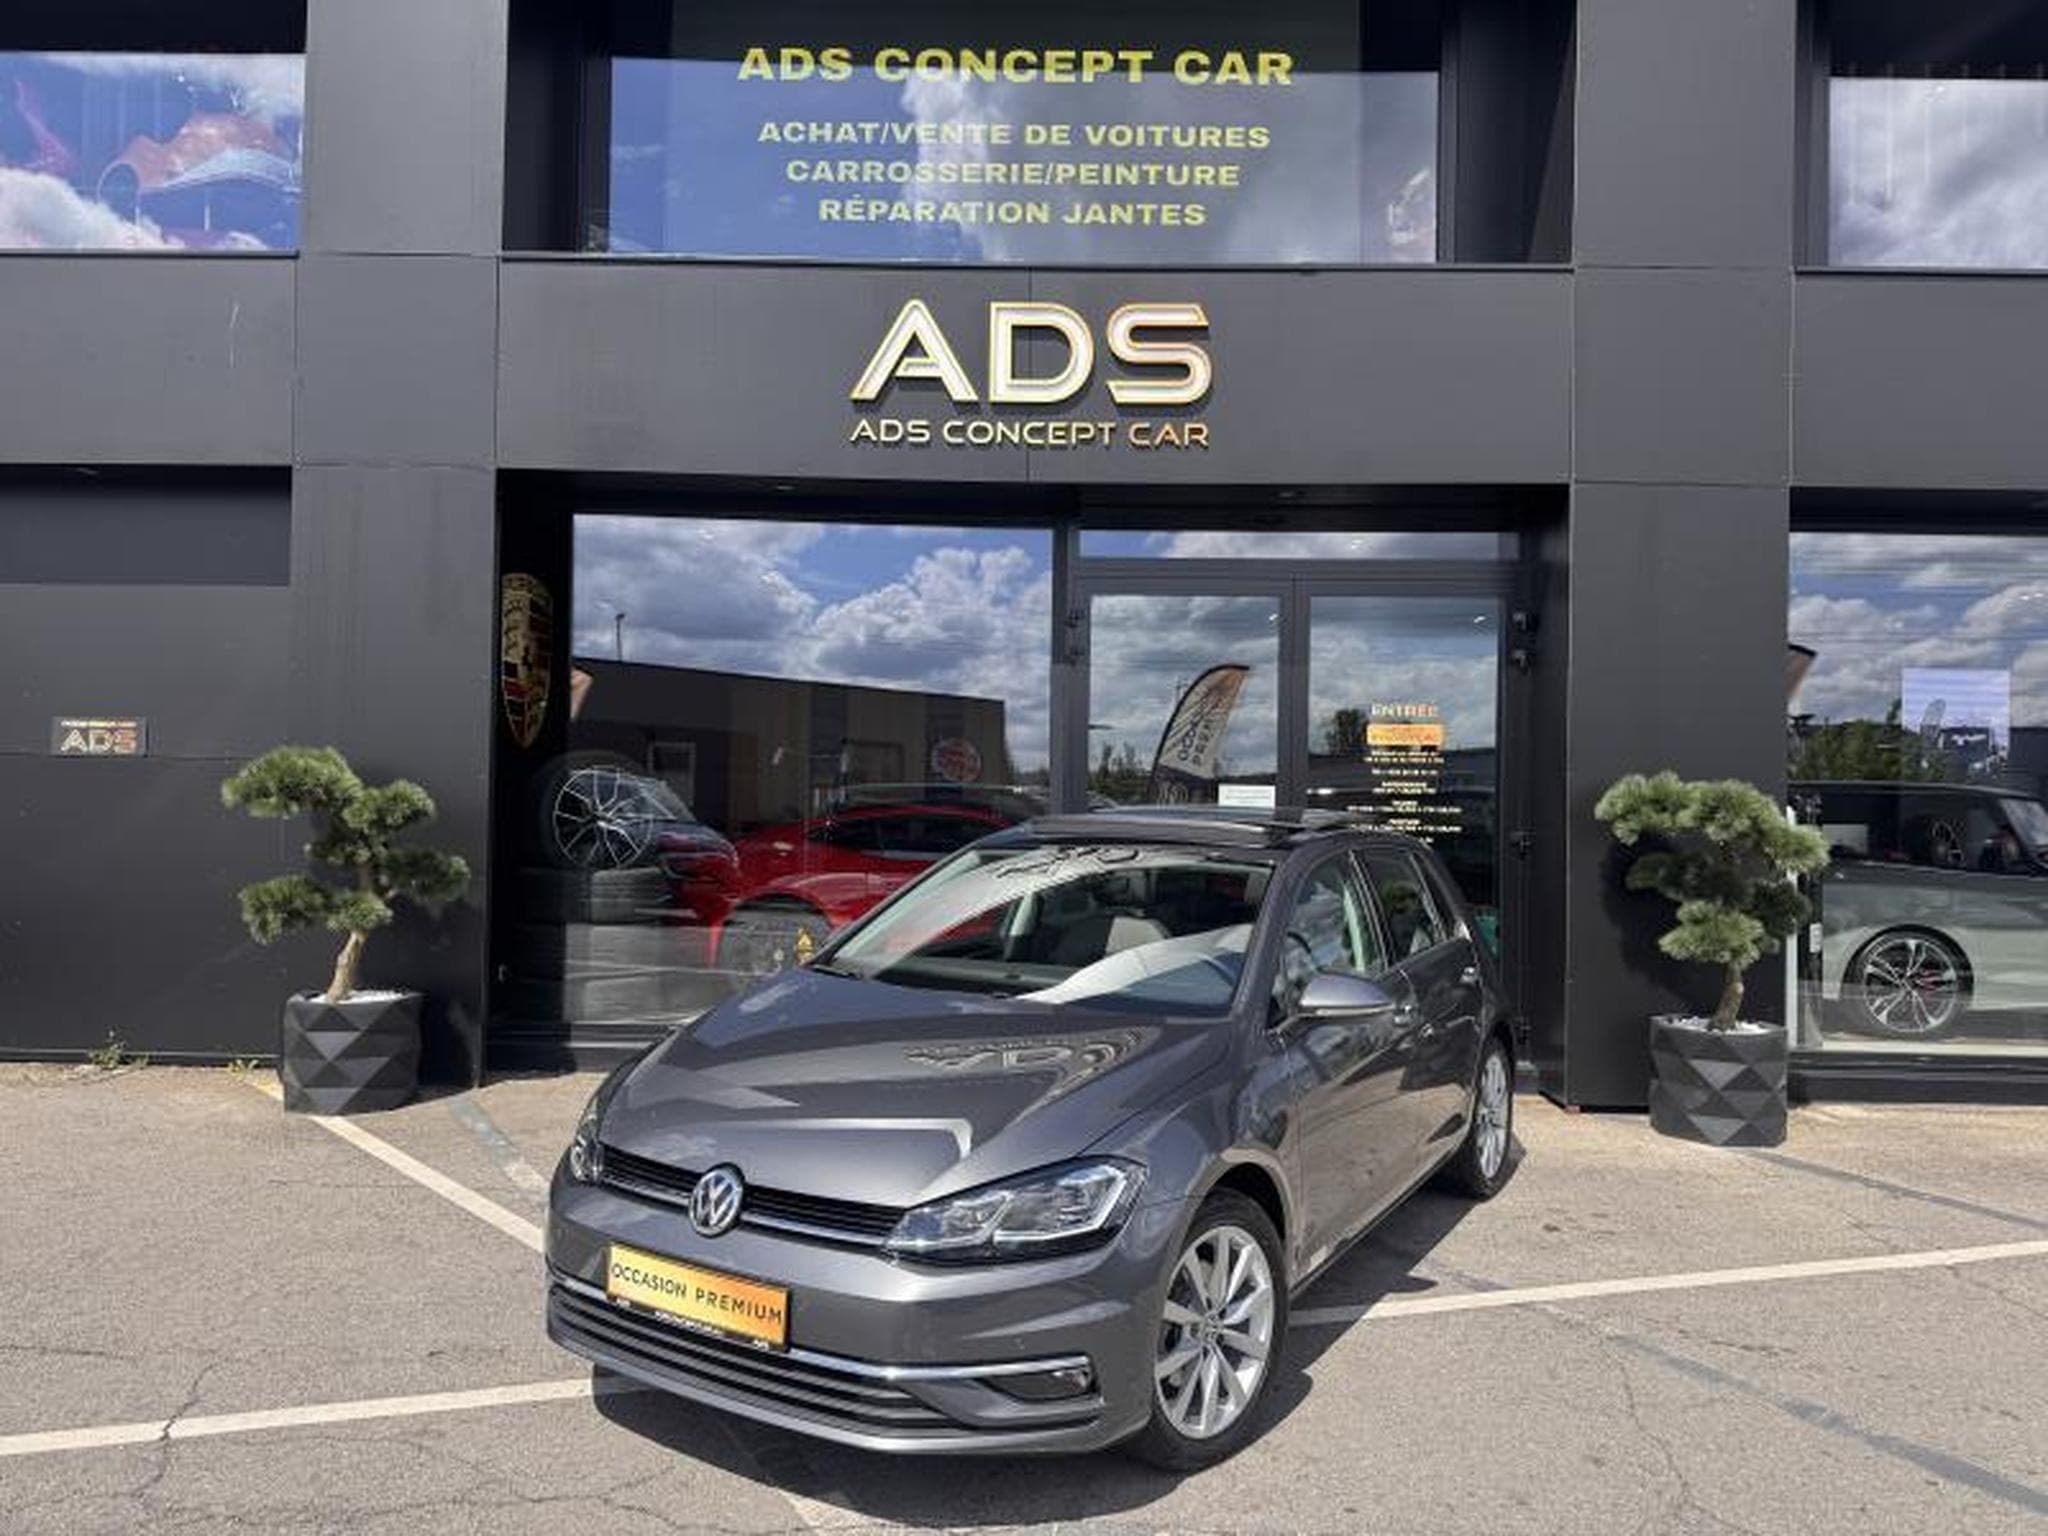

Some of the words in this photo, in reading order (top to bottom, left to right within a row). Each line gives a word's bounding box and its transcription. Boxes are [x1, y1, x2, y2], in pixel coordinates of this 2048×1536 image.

[737, 47, 853, 82] ADS
[874, 48, 1154, 83] CONCEPT
[1173, 51, 1294, 86] CAR
[757, 122, 1012, 146] ACHAT/VENTE
[1024, 124, 1071, 146] DE
[1083, 125, 1272, 148] VOITURES
[785, 161, 1241, 187] CARROSSERIE/PEINTURE
[818, 193, 1050, 224] RÉPARATION
[1063, 203, 1208, 227] JANTES
[849, 299, 1213, 405] ADS
[849, 418, 931, 444] ADS
[942, 420, 1115, 446] CONCEPT
[1129, 422, 1210, 448] CAR
[60, 729, 138, 753] ADS
[611, 1263, 687, 1298] OCCASION
[695, 1286, 783, 1326] PREMIUM
